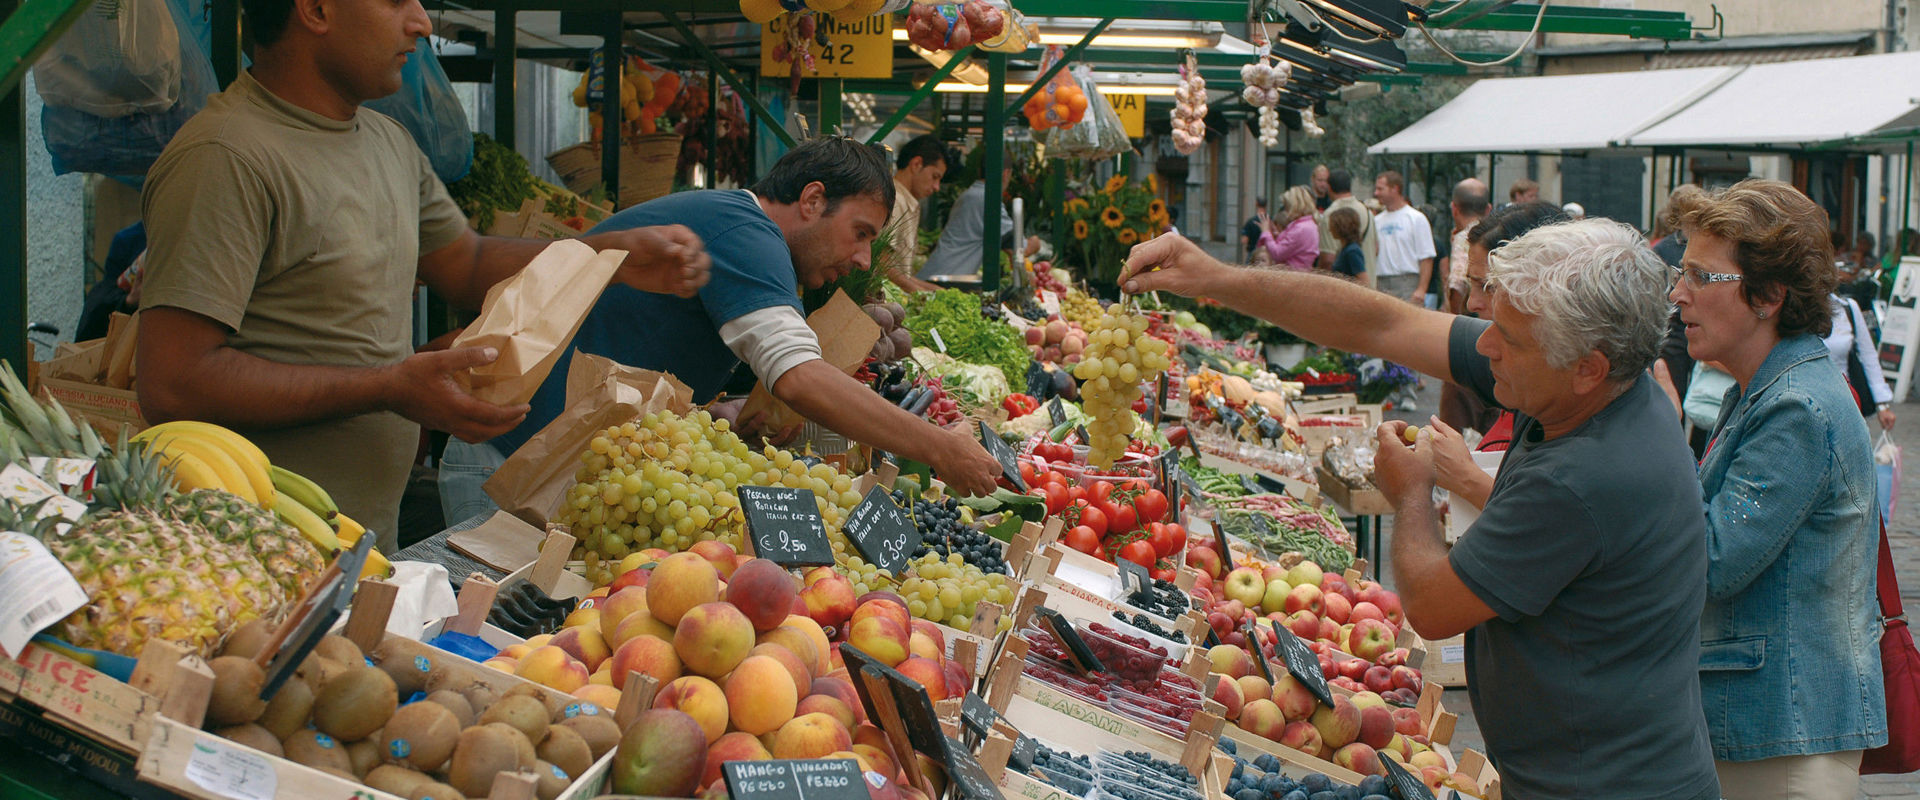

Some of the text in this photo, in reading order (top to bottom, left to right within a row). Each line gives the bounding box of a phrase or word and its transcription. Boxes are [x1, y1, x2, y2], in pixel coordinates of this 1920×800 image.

[821, 44, 854, 65] 42
[1051, 699, 1124, 736] ADAMI
[735, 764, 785, 779] MANGO
